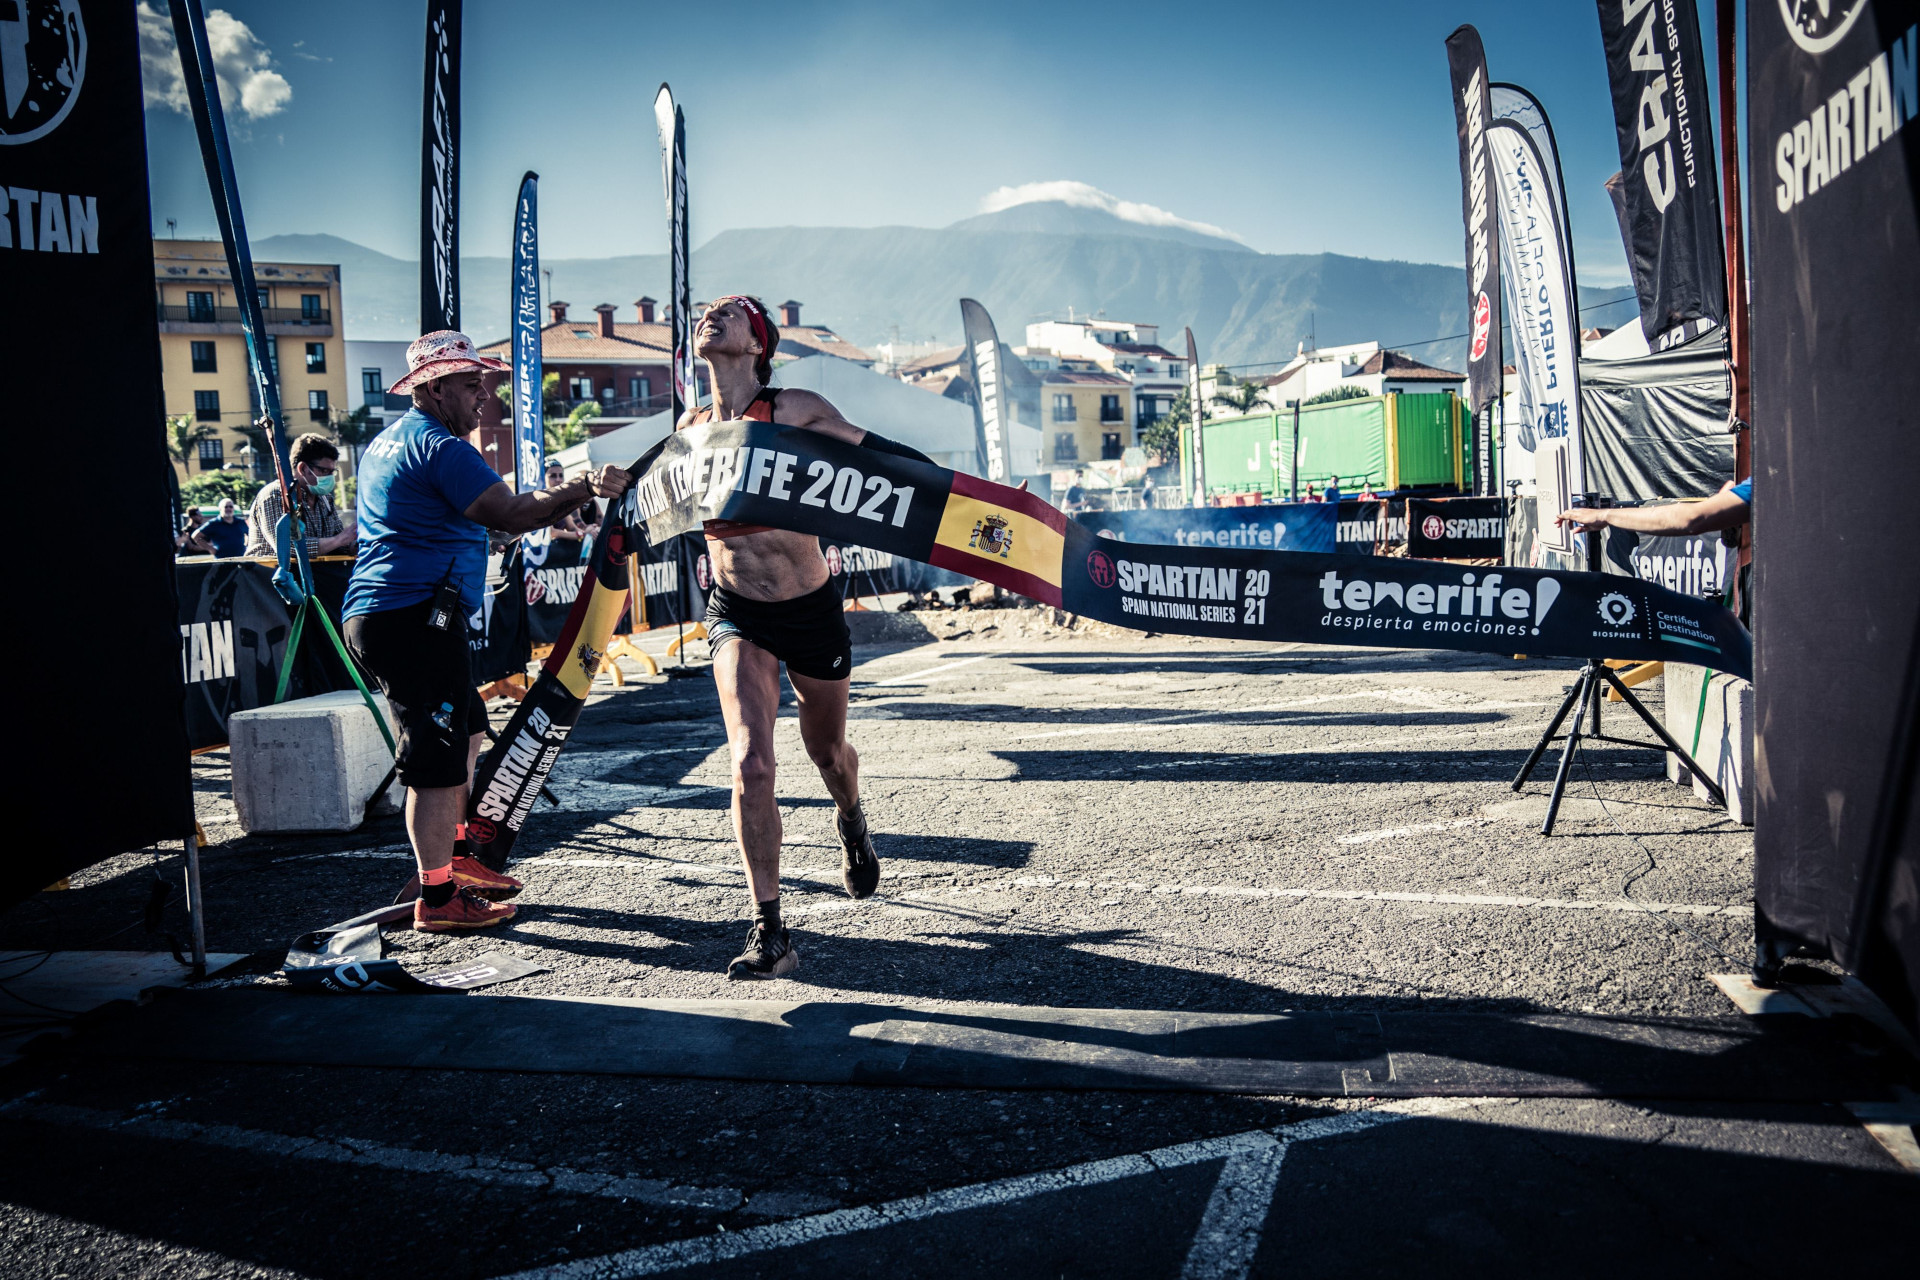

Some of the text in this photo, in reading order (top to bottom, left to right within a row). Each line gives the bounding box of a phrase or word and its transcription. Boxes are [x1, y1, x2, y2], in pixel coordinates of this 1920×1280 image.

[1669, 51, 1697, 189] FUNCTIONAL
[1776, 22, 1919, 214] SPARTAN
[432, 50, 446, 312] CRAFT
[1464, 66, 1489, 296] SPARTAN
[974, 339, 1004, 482] SPARTAN
[668, 447, 798, 504] TENERIFE
[800, 460, 915, 528] 2021
[1175, 521, 1287, 549] tenerife!
[1117, 559, 1271, 601] SPARTAN 20
[1121, 596, 1266, 625] SPAIN NATIONAL SERIES 21
[1319, 570, 1561, 636] tenerife!
[1321, 612, 1526, 636] despierta emociones
[1592, 630, 1641, 640] BIOSPHERE
[1656, 610, 1700, 629] Certified
[1658, 621, 1717, 643] Destination
[476, 706, 551, 822] SPARTAN 20
[506, 724, 572, 832] SPAIN NATIONAL SERIES 21
